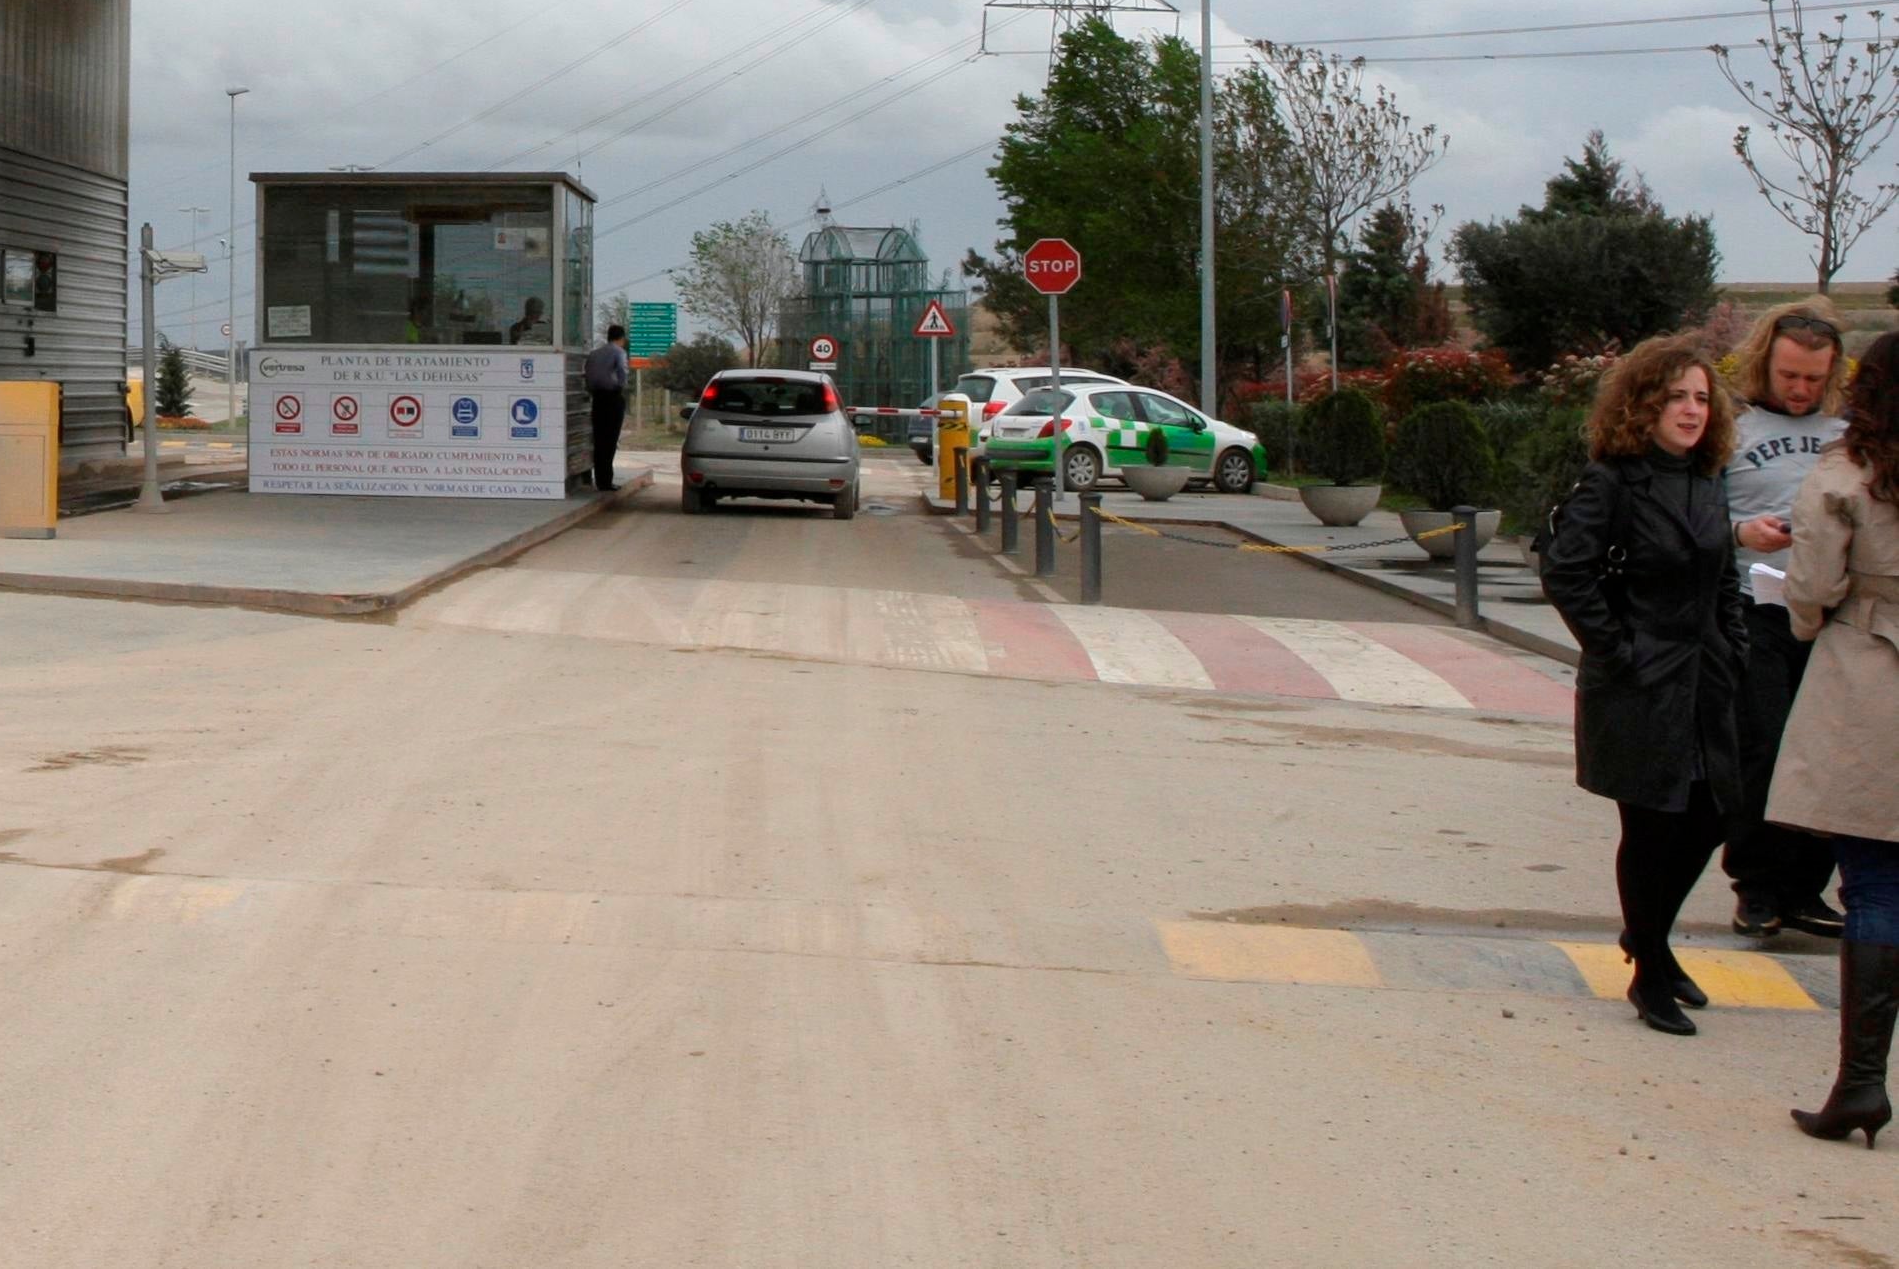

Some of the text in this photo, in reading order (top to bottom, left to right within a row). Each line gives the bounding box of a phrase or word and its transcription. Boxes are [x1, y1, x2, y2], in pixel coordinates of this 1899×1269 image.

[1029, 260, 1075, 272] STOP
[816, 344, 830, 353] 40
[321, 355, 491, 367] PLANTA DE TRATAMIENTO
[333, 371, 350, 381] DE
[270, 448, 543, 462] ESTAS NORMAS SON DE OBLIGADO CUMPLIMIENTO PARA
[1745, 437, 1795, 467] PEPE
[272, 462, 299, 472] TODO
[301, 463, 313, 472] EL
[315, 463, 364, 473] PERSONAL
[367, 464, 387, 474] QUE
[435, 466, 442, 475] A
[445, 466, 463, 475] LAS
[465, 466, 542, 476] INSTALACIONES
[263, 480, 313, 490] RESPETAR
[317, 482, 331, 491] LA
[413, 483, 419, 491] Y
[424, 483, 469, 493] NORMAS
[472, 484, 486, 494] DE
[489, 484, 517, 494] CADA
[520, 486, 551, 496] ZONA
